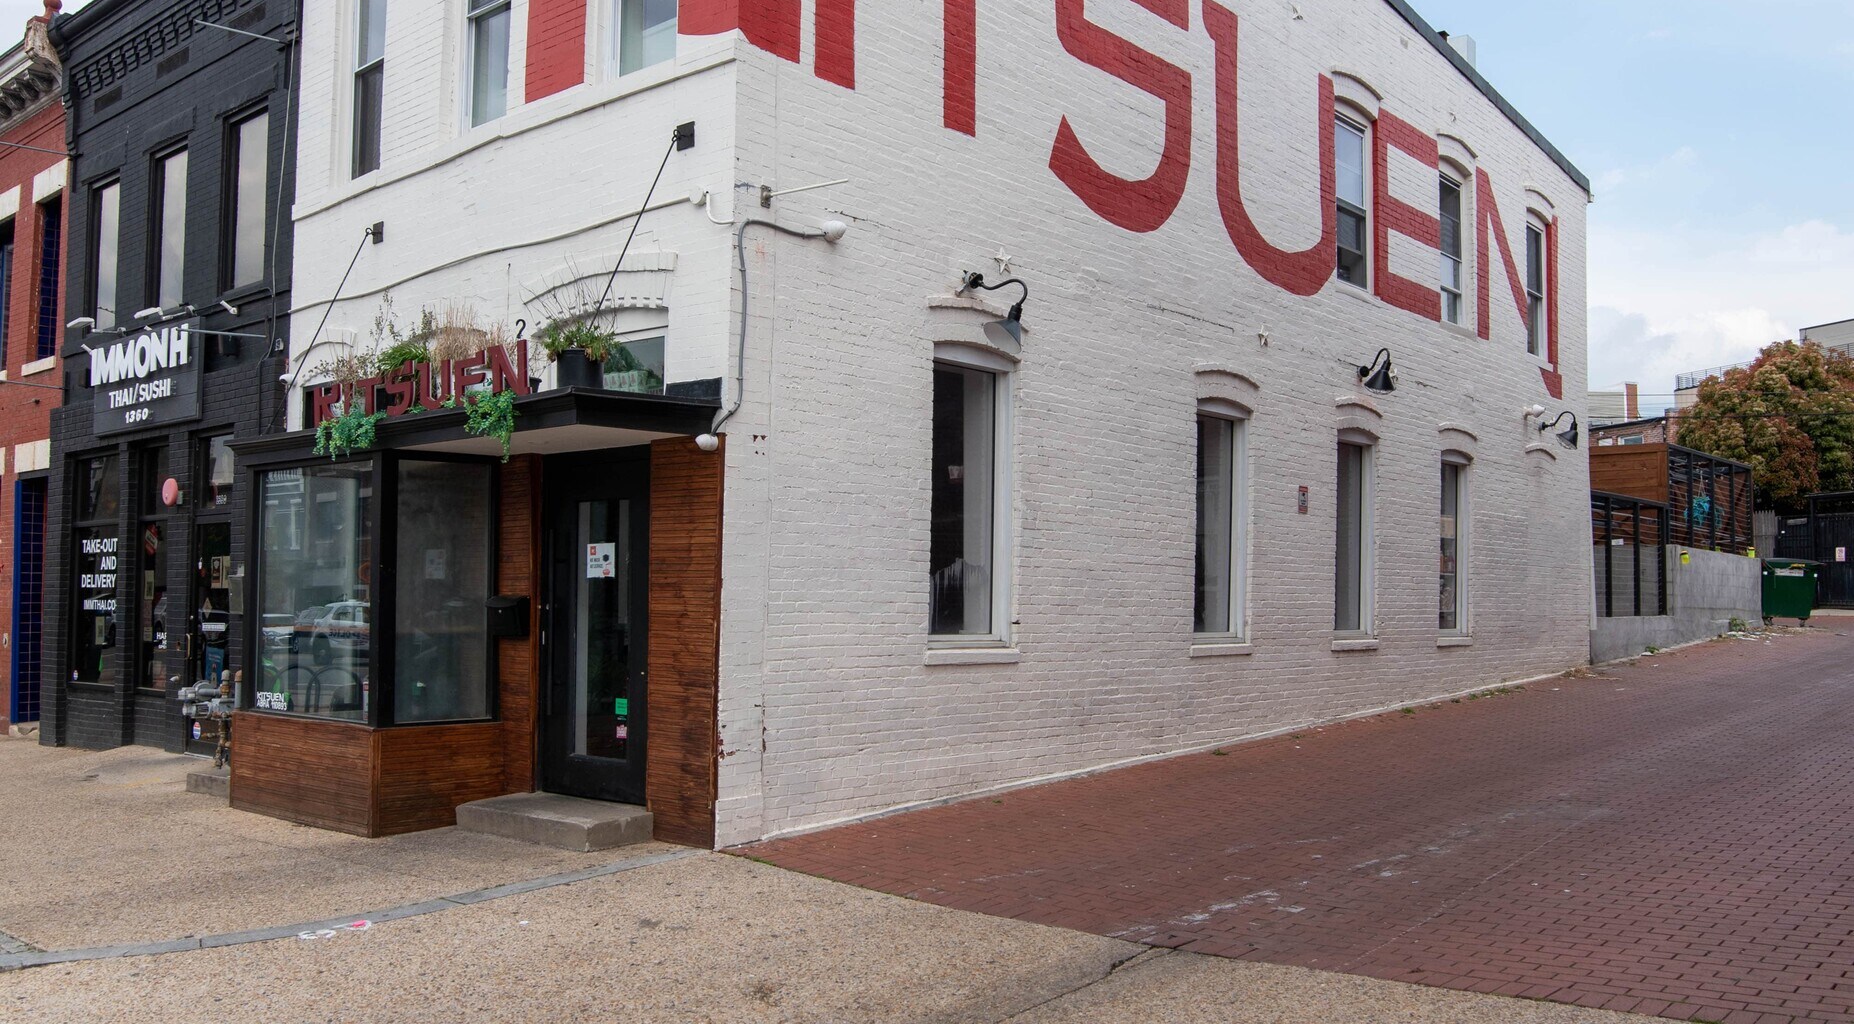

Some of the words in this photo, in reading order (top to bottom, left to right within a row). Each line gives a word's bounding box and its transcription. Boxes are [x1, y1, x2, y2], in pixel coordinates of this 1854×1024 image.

[109, 378, 171, 409] THAI/SUSHI
[125, 407, 149, 424] 1360
[82, 538, 118, 553] TAKE-OUT
[101, 557, 117, 570] AND
[81, 574, 117, 588] DELIVERY
[83, 599, 117, 610] IMMTHAI.CO
